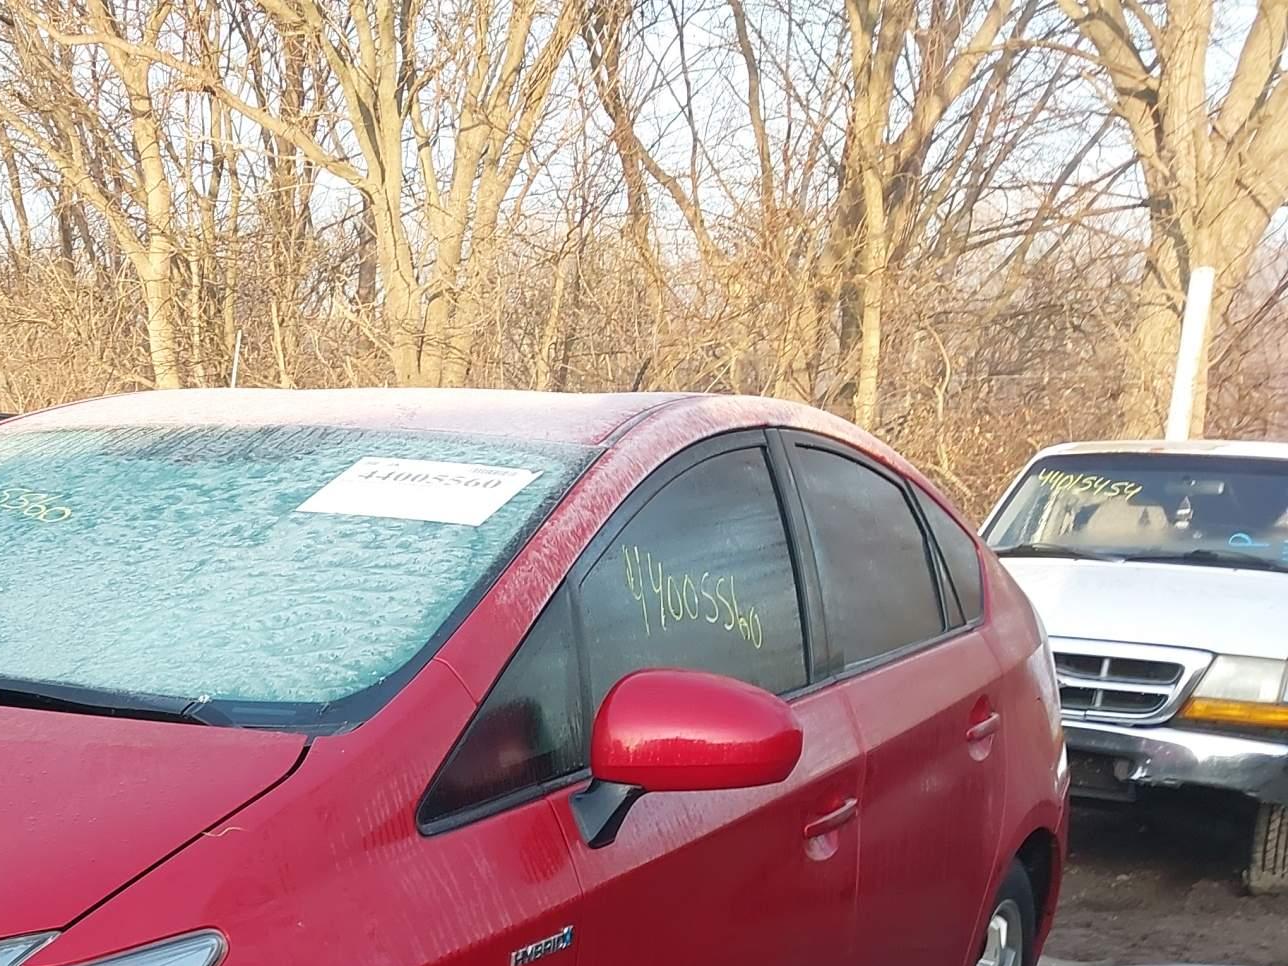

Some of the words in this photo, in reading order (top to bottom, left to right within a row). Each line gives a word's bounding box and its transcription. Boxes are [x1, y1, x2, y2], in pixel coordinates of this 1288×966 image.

[358, 469, 502, 489] 44005560
[1038, 467, 1143, 501] 44015454
[622, 544, 762, 649] 44005560
